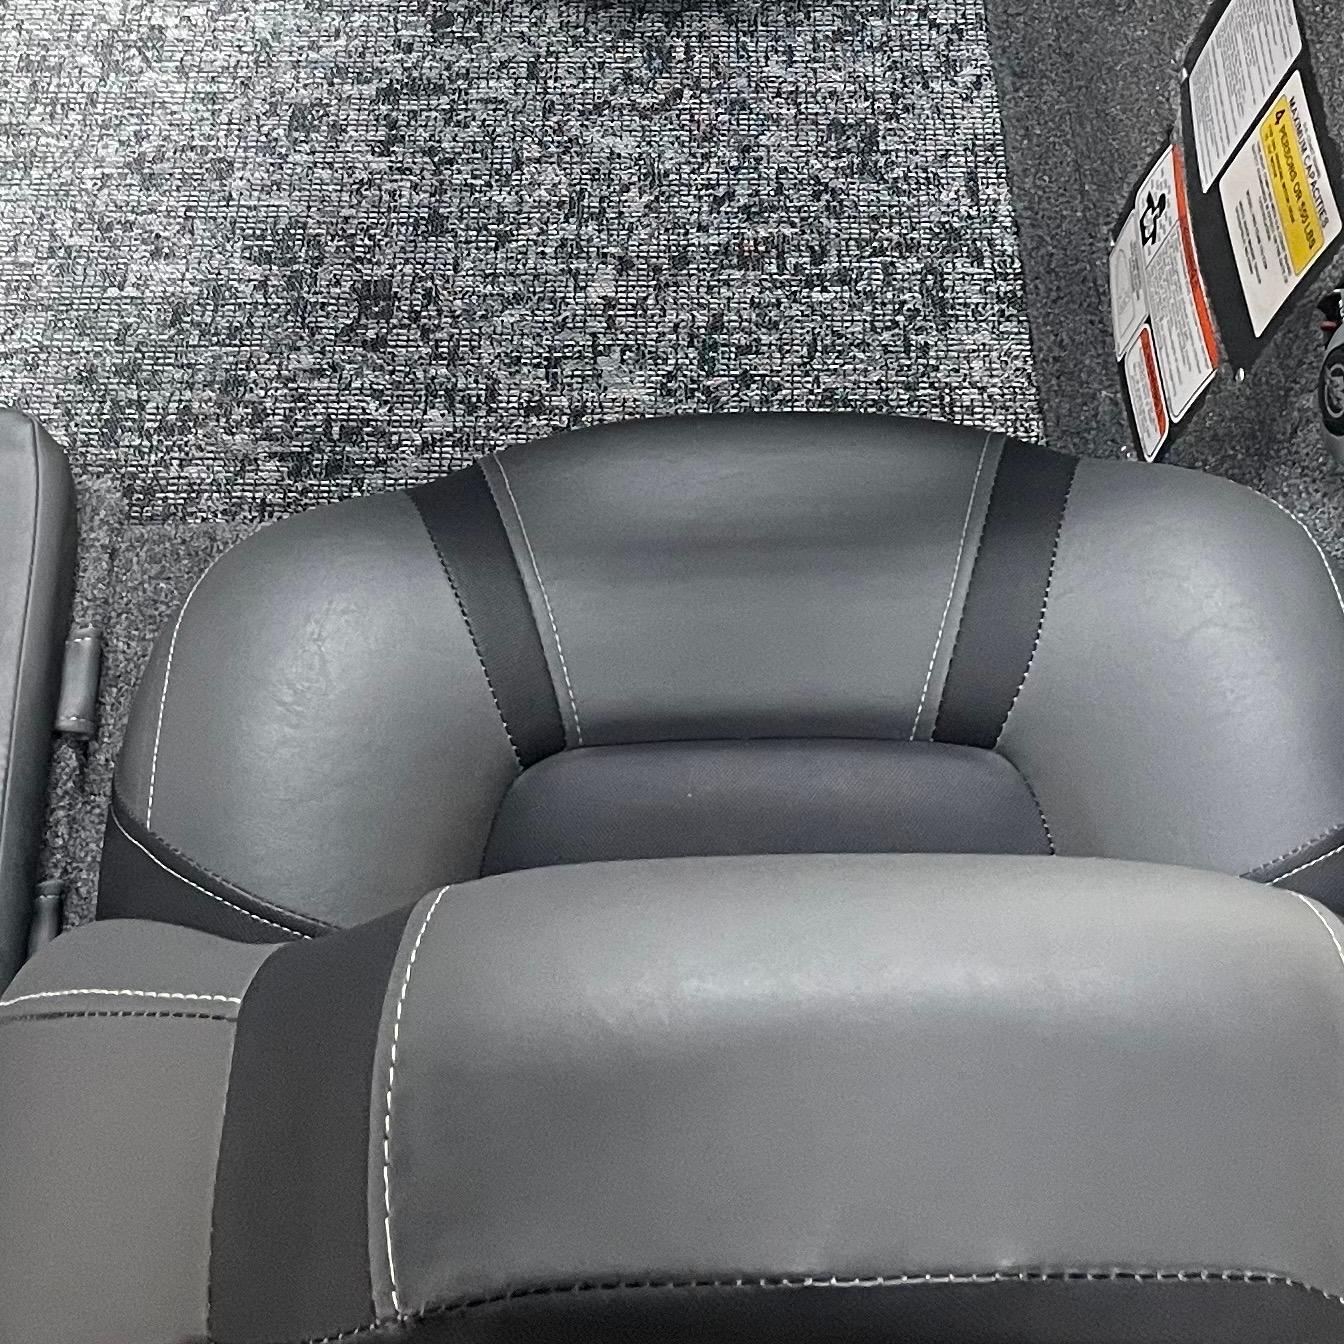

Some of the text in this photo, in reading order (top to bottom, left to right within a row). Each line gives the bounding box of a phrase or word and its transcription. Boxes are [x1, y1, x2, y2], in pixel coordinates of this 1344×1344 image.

[1274, 109, 1286, 125] 4
[1289, 96, 1307, 154] MAXIMUM
[1304, 155, 1329, 228] CAPACITIES
